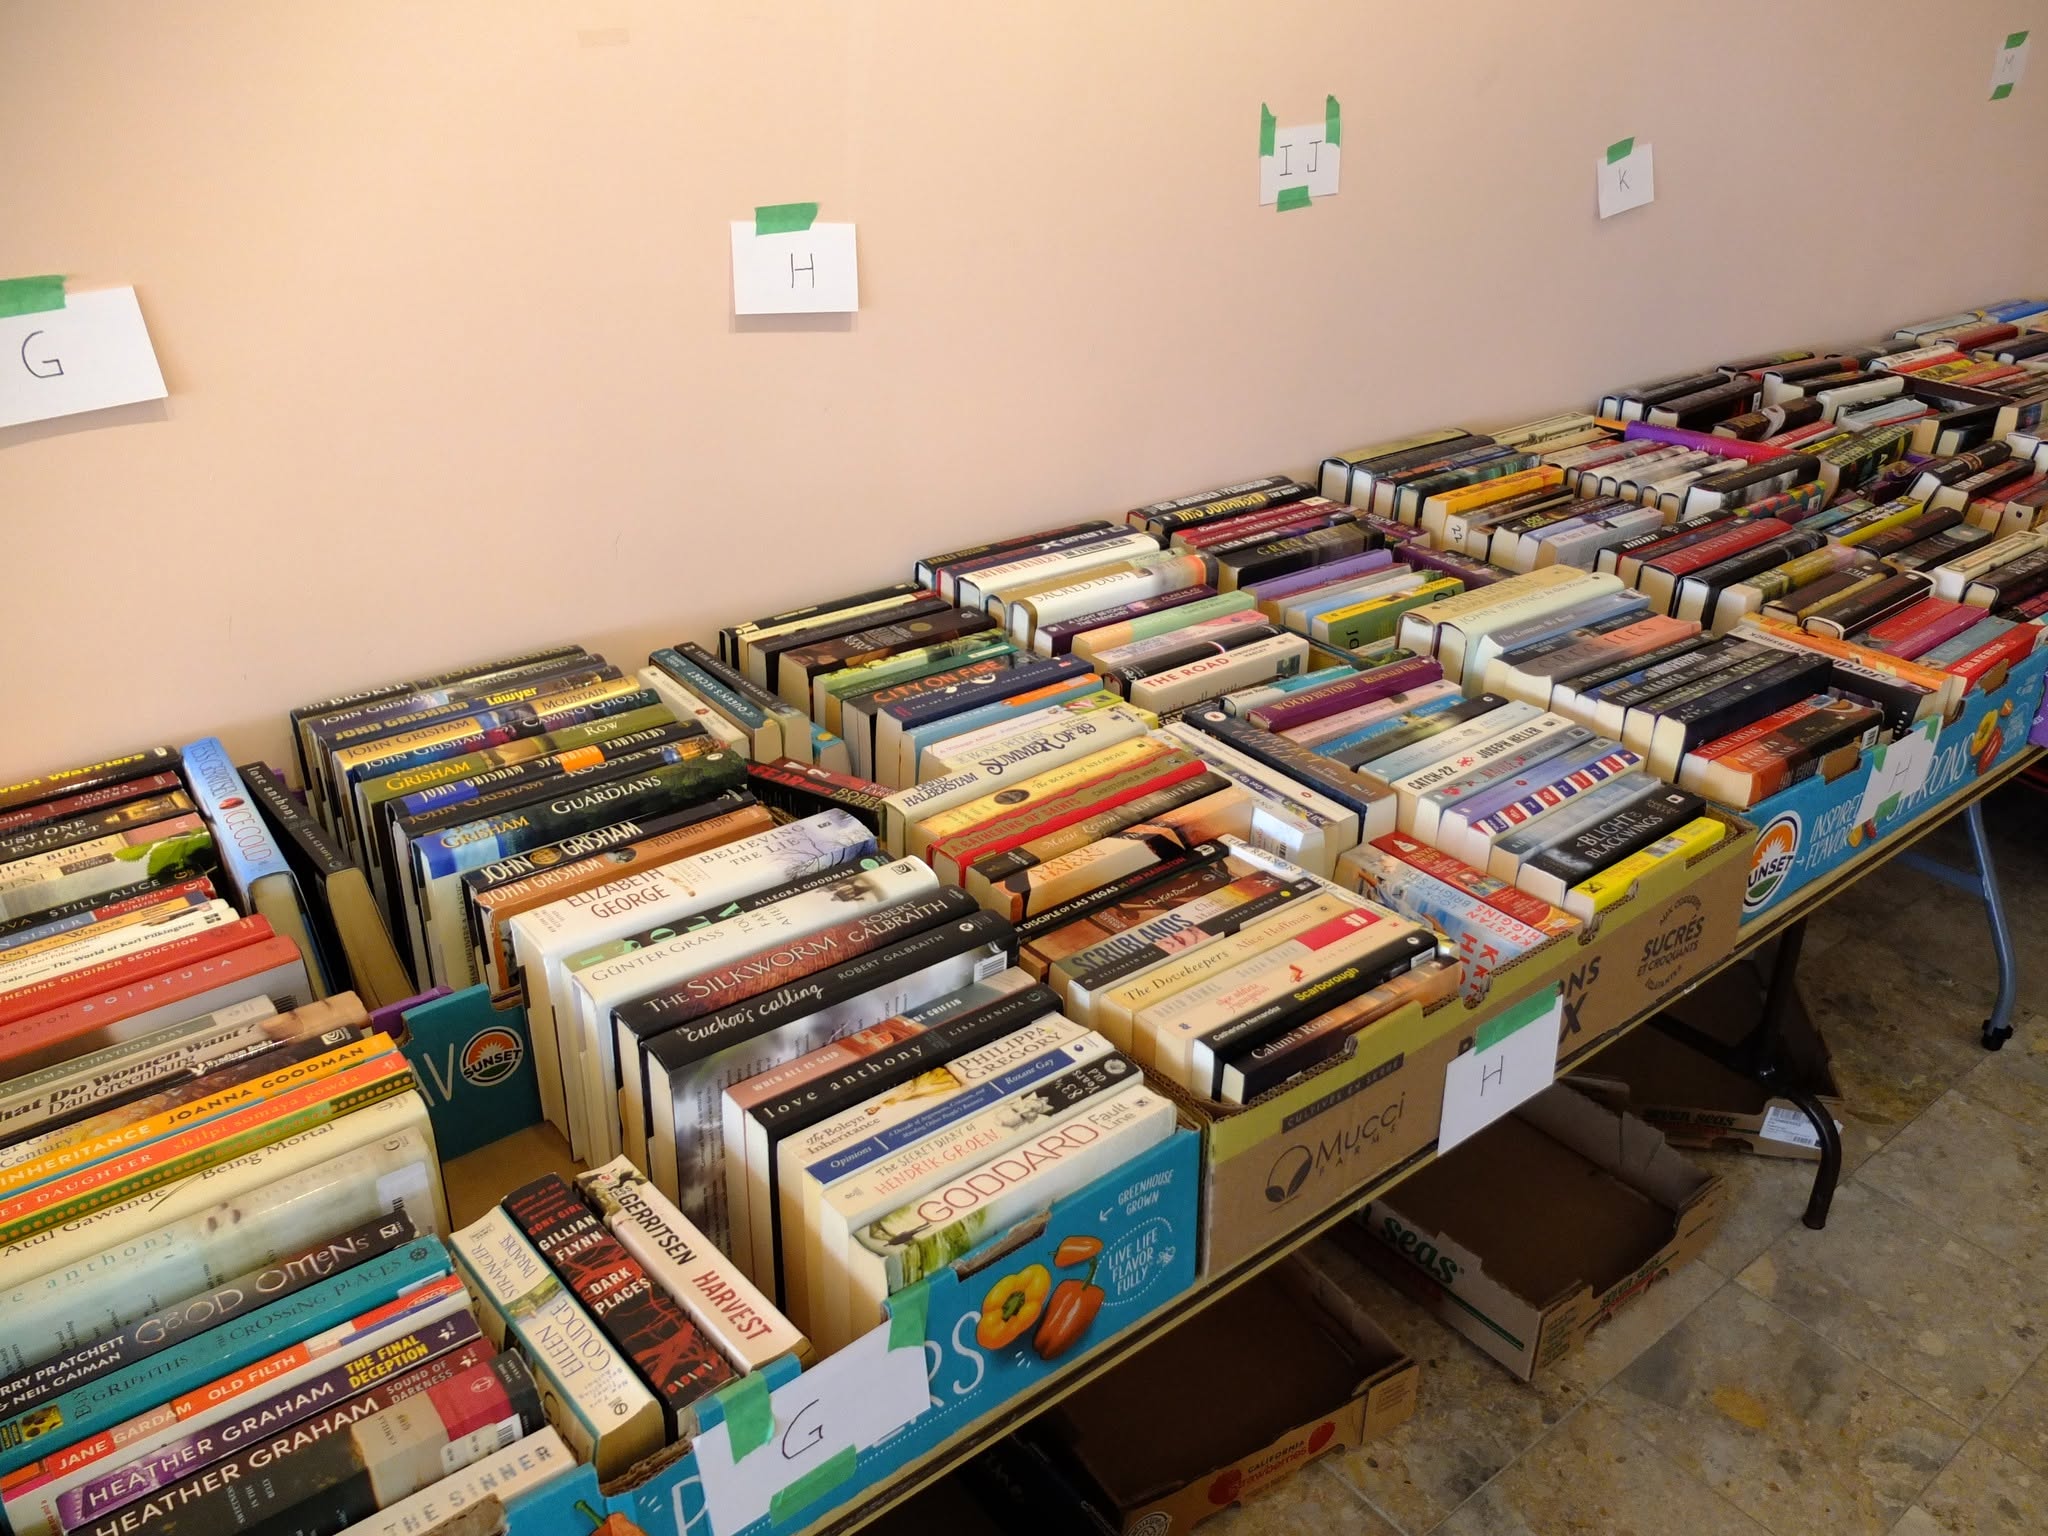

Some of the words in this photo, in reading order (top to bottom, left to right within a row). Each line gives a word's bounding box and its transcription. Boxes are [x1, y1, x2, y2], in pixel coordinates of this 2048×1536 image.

[1306, 140, 1323, 173] J
[1618, 168, 1630, 192] K
[790, 253, 815, 288] H
[22, 330, 64, 379] G
[872, 686, 910, 704] CITY
[911, 674, 949, 694] ON
[1142, 672, 1179, 689] THE
[1179, 657, 1230, 677] ROAD
[1616, 689, 1643, 702] JANE
[1644, 675, 1687, 695] HARPER
[321, 710, 362, 726] JOHN
[522, 701, 587, 728] CAMINO
[589, 689, 650, 710] GHOSTS
[541, 686, 609, 711] MOUNTAIN
[335, 720, 382, 741] JOHN
[384, 701, 470, 728] GRISHAM
[345, 740, 392, 759] JOHN
[395, 718, 471, 745] GRISHAM
[583, 720, 620, 737] ROW
[363, 751, 408, 771] JOHN
[412, 733, 486, 756] GRISHAM
[977, 734, 1066, 775] SUMMER
[1476, 739, 1509, 758] JOSEPH
[1509, 726, 1542, 744] HELLER
[46, 752, 146, 781] Warriors
[385, 761, 472, 793] GRISHAM
[1408, 765, 1459, 790] CATCH-22
[550, 775, 663, 816] GUARDIANS
[902, 772, 979, 808] HALBERSTAM
[11, 840, 58, 854] EVIL
[64, 823, 100, 841] ACT
[44, 819, 87, 836] ONE
[440, 814, 531, 850] GRISHAM
[698, 822, 808, 864] BELIEVING
[1579, 813, 1633, 847] BLIGHT
[1584, 814, 1664, 860] BLACKWINGS
[479, 855, 536, 884] JOHN
[559, 820, 645, 856] GRISHAM
[729, 848, 764, 867] THE
[1748, 855, 1794, 888] UNSET
[49, 898, 101, 918] STILL
[109, 879, 162, 900] ALICE
[485, 880, 531, 906] JOHN
[533, 856, 606, 889] GRISHAM
[564, 868, 666, 908] ELIZABETH
[754, 888, 802, 907] ALLEGRA
[802, 868, 855, 890] GOODMAN
[590, 883, 672, 920] GEORGE
[846, 899, 949, 942] GALBRAITH
[858, 900, 917, 927] ROBERT
[1022, 910, 1062, 932] DISCIPLE
[1071, 898, 1089, 910] LAS
[1088, 885, 1119, 905] VEGAS
[1235, 931, 1266, 953] Alice
[1266, 911, 1313, 939] Hoffman
[1466, 911, 1531, 947] KRISTAN
[1475, 904, 1542, 942] HIGGINS
[1642, 916, 1705, 962] SUCRÉS
[60, 960, 123, 984] GILDINER
[127, 936, 200, 962] SEDUCTION
[590, 950, 669, 982] GÜNTER
[668, 928, 726, 959] GRASS
[837, 959, 881, 981] ROBERT
[882, 933, 946, 962] GALBRAITH
[1072, 913, 1195, 973] SCRUBLANDS
[642, 992, 691, 1015] THE
[686, 934, 839, 1001] SILKWORM
[1123, 980, 1153, 1002] The
[1154, 948, 1231, 990] Dovekeepers
[1292, 965, 1360, 1002] Scarborough
[758, 983, 826, 1016] calling
[926, 998, 963, 1018] GRIFFIN
[948, 1019, 978, 1038] LISA
[978, 999, 1027, 1024] GENOVA
[955, 1024, 1047, 1070] PHILIPPA
[1212, 1019, 1248, 1043] Catherine
[1250, 1026, 1303, 1061] Calum's
[1303, 1014, 1335, 1036] Road
[33, 1040, 151, 1083] EMANCIPATION
[47, 1083, 89, 1102] Do
[91, 1049, 183, 1087] Women
[463, 1049, 522, 1079] SUNSET
[963, 1030, 1064, 1082] GREGORY
[1480, 1054, 1505, 1097] H
[167, 1088, 253, 1125] JOANNA
[261, 1047, 365, 1089] GOODMAN
[762, 1089, 819, 1120] love
[828, 1042, 926, 1093] anthony
[47, 1093, 92, 1116] Dan
[1087, 1101, 1130, 1126] Fault
[1097, 1110, 1138, 1134] Line
[829, 1144, 874, 1170] Opinions
[872, 1154, 940, 1196] HENDRIK
[941, 1129, 1002, 1165] GROEN
[895, 1143, 936, 1169] SECRET
[936, 1130, 965, 1152] DIARY
[4, 1230, 56, 1257] Atul
[61, 1189, 168, 1232] Gawande
[201, 1152, 263, 1181] Being
[266, 1123, 335, 1155] Mortal
[36, 1153, 153, 1203] DAUGHTER
[915, 1120, 1100, 1226] GODDARD
[1116, 1169, 1175, 1207] GREENHOUSE
[1125, 1190, 1160, 1217] GROWN
[537, 1214, 599, 1252] GILLIAN
[555, 1229, 605, 1264] FLYNN
[1106, 1243, 1135, 1271] LIVE
[1132, 1227, 1159, 1253] LIFE
[588, 1264, 634, 1297] DARK
[618, 1192, 698, 1267] GERRITSEN
[691, 1268, 774, 1343] HARVEST
[1110, 1246, 1155, 1284] FLAVOR
[1116, 1269, 1149, 1296] FULLY
[593, 1276, 653, 1316] PLACES
[229, 1292, 327, 1342] CROSSING
[549, 1298, 613, 1373] GOUDGE
[34, 1334, 126, 1382] PRATCHETT
[344, 1355, 376, 1375] THE
[376, 1333, 421, 1360] FINAL
[348, 1344, 429, 1390] DECEPTION
[535, 1324, 585, 1379] EILEEN
[12, 1383, 50, 1406] NEIL
[52, 1350, 122, 1388] GAIMAN
[385, 1367, 430, 1396] SOUND
[390, 1369, 454, 1406] DARKNESS
[58, 1440, 108, 1470] JANE
[112, 1400, 193, 1445] GARDAM
[207, 1378, 244, 1401] OLD
[247, 1354, 297, 1383] FILTH
[781, 1398, 824, 1460] G
[88, 1436, 214, 1507] HEATHER
[221, 1381, 335, 1443] GRAHAM
[1247, 1440, 1305, 1473] CALIFORNIA
[95, 1462, 242, 1536] HEATHER
[248, 1397, 380, 1469] GRAHAM
